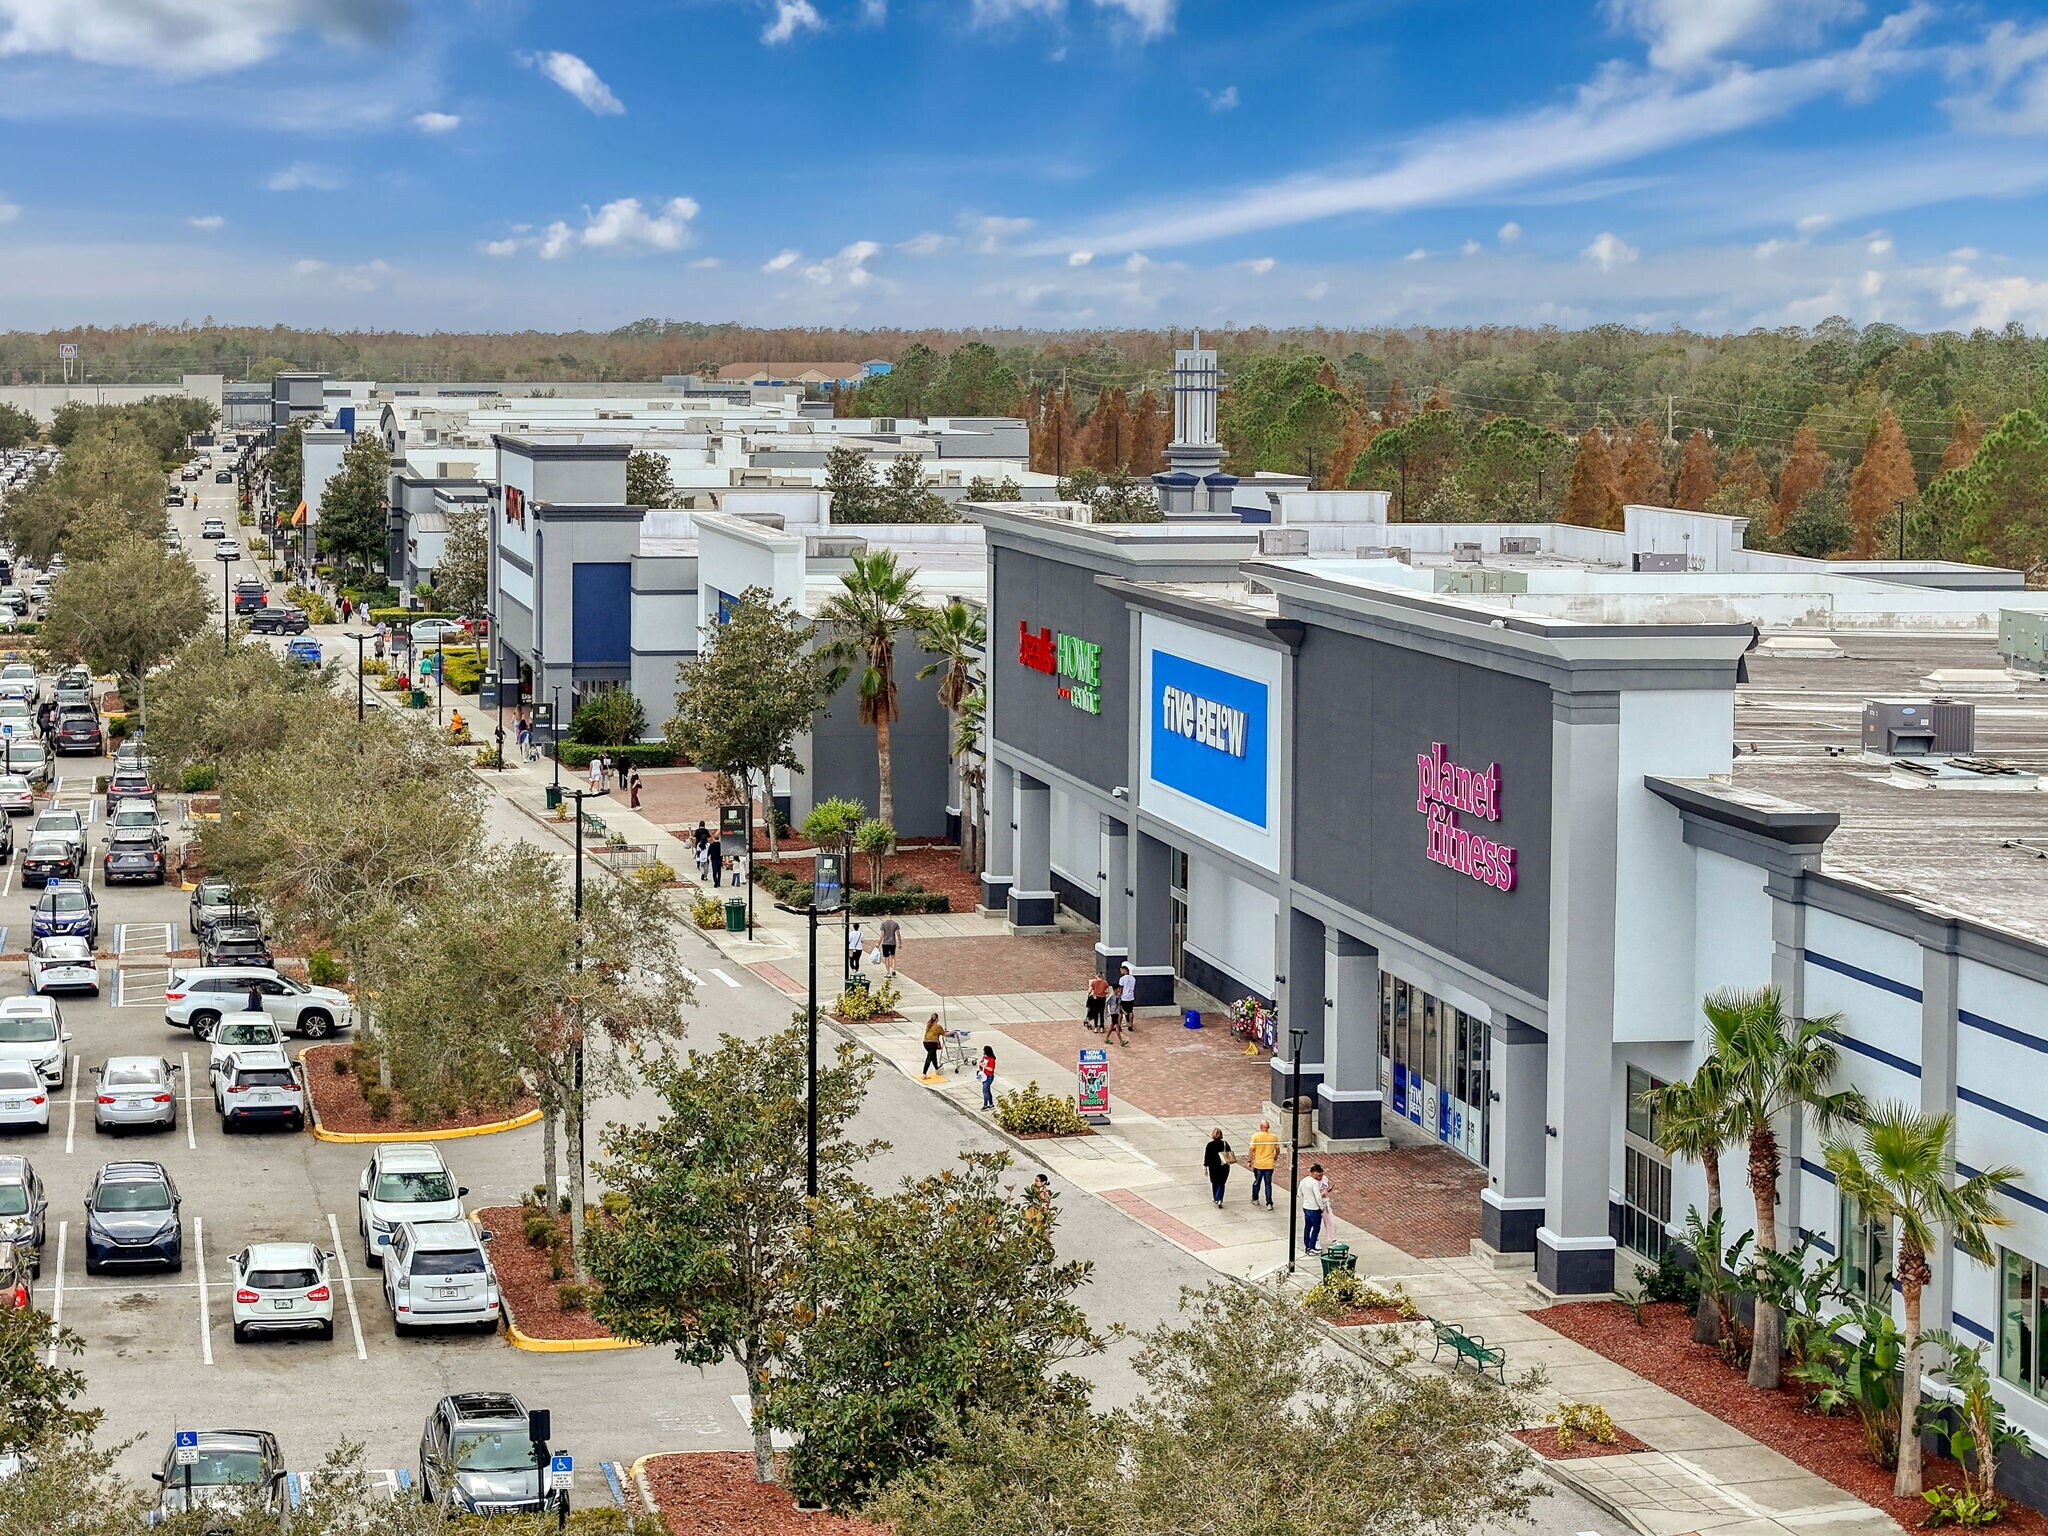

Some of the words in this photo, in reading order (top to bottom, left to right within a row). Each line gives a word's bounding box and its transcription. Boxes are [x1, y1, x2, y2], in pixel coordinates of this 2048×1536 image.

[1057, 632, 1102, 687] HOME
[1163, 684, 1197, 739] five
[1416, 741, 1502, 822] planet
[1426, 802, 1517, 893] fitness
